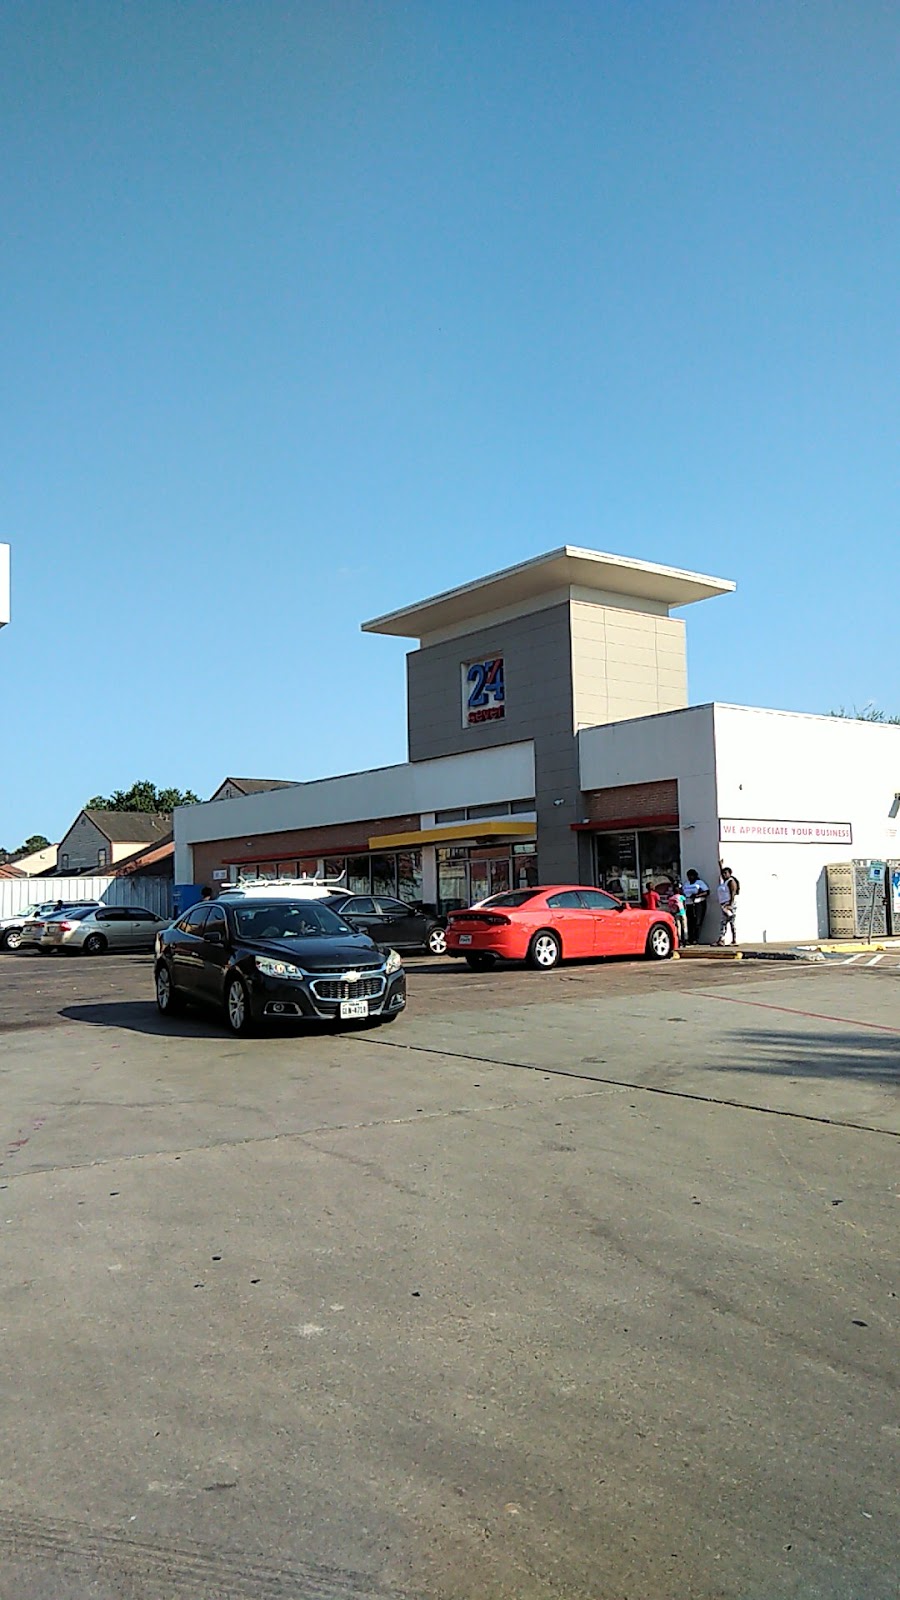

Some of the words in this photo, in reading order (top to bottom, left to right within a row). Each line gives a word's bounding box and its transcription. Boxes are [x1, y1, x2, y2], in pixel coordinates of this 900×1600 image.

[723, 825, 735, 834] WE
[739, 826, 787, 835] APPRECIATE
[791, 827, 813, 836] YOUR
[815, 828, 849, 837] BUSINESS
